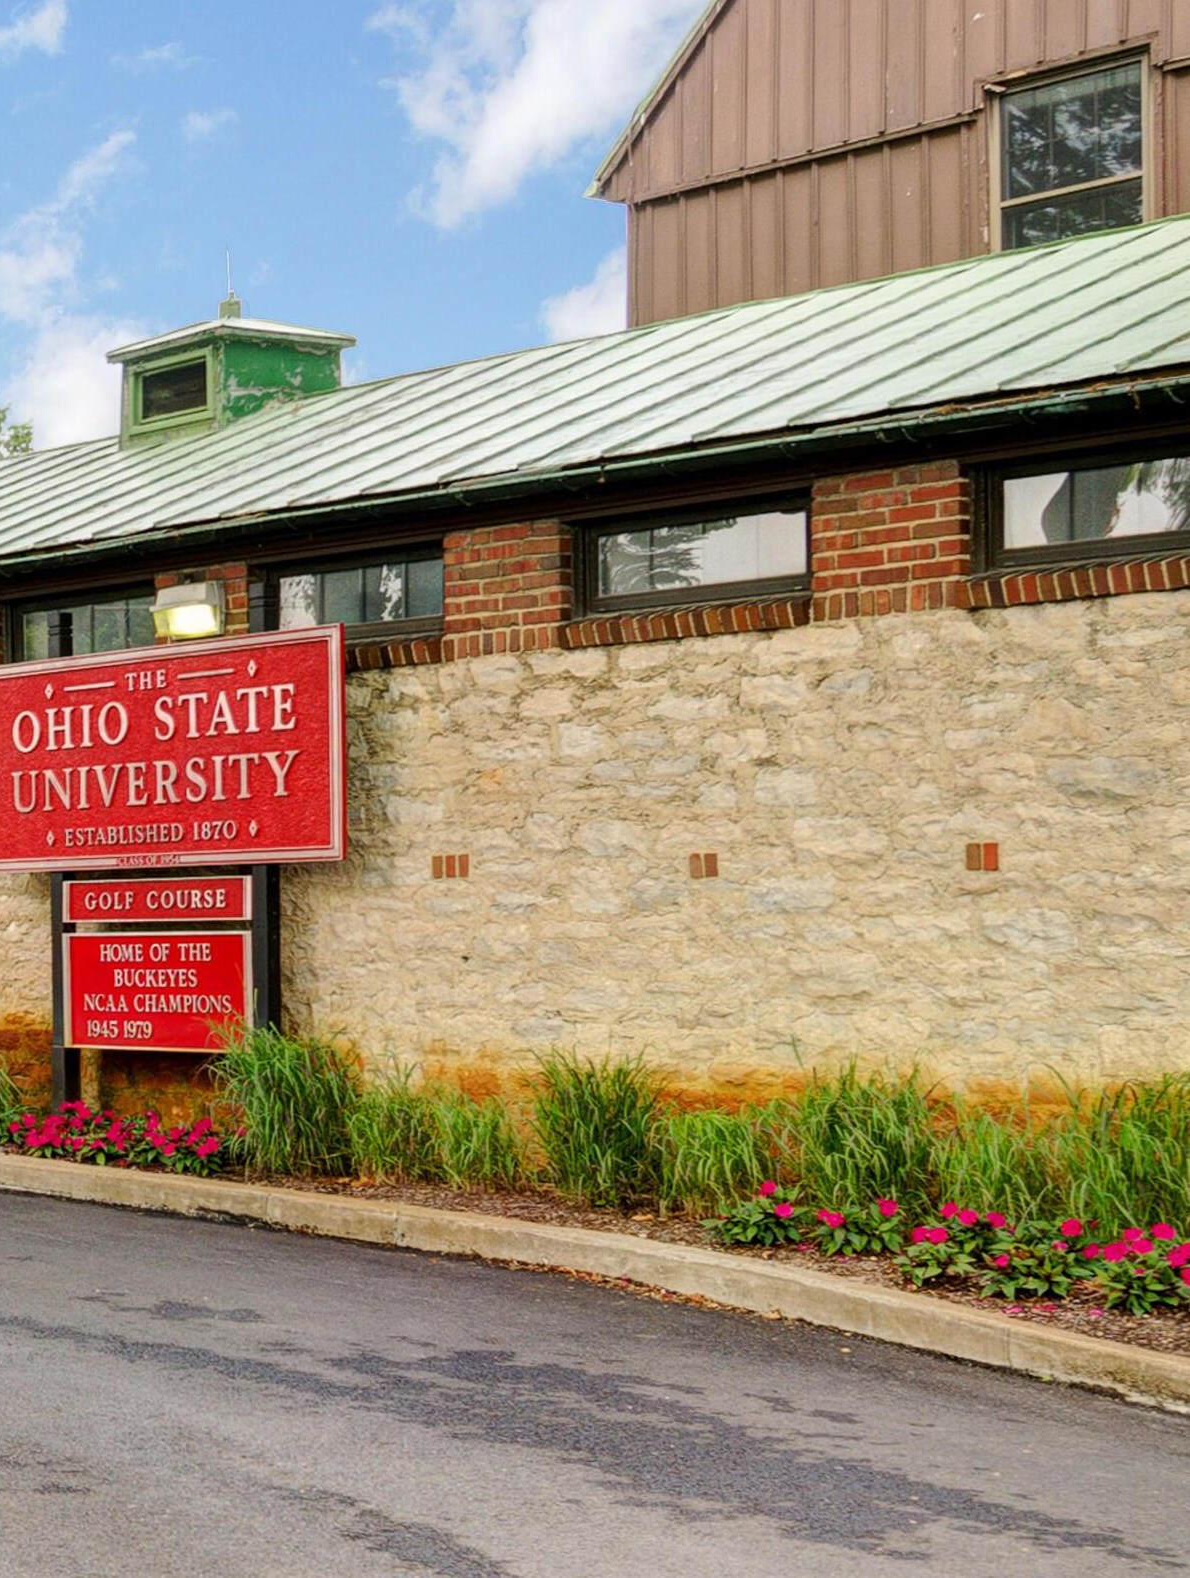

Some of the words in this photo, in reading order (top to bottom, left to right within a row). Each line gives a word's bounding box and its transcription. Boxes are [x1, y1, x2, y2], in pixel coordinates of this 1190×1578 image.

[125, 669, 167, 691] THE
[12, 701, 128, 753] OHIO
[154, 683, 297, 741] STATE
[11, 750, 300, 813] UNIVERSITY
[65, 822, 183, 847] ESTABLISHED
[192, 820, 237, 840] 1870
[118, 856, 144, 866] CLASS
[146, 855, 157, 865] OF
[84, 891, 134, 910] GOLF
[146, 889, 226, 909] COURSE
[99, 944, 143, 962] HOME
[149, 943, 170, 962] OF
[178, 943, 211, 962] THE
[114, 969, 197, 987] BUCKEYES
[83, 994, 128, 1012] NCAA
[133, 994, 232, 1013] CHAMPIONS
[86, 1020, 118, 1038] 1945
[123, 1020, 152, 1038] 1979
